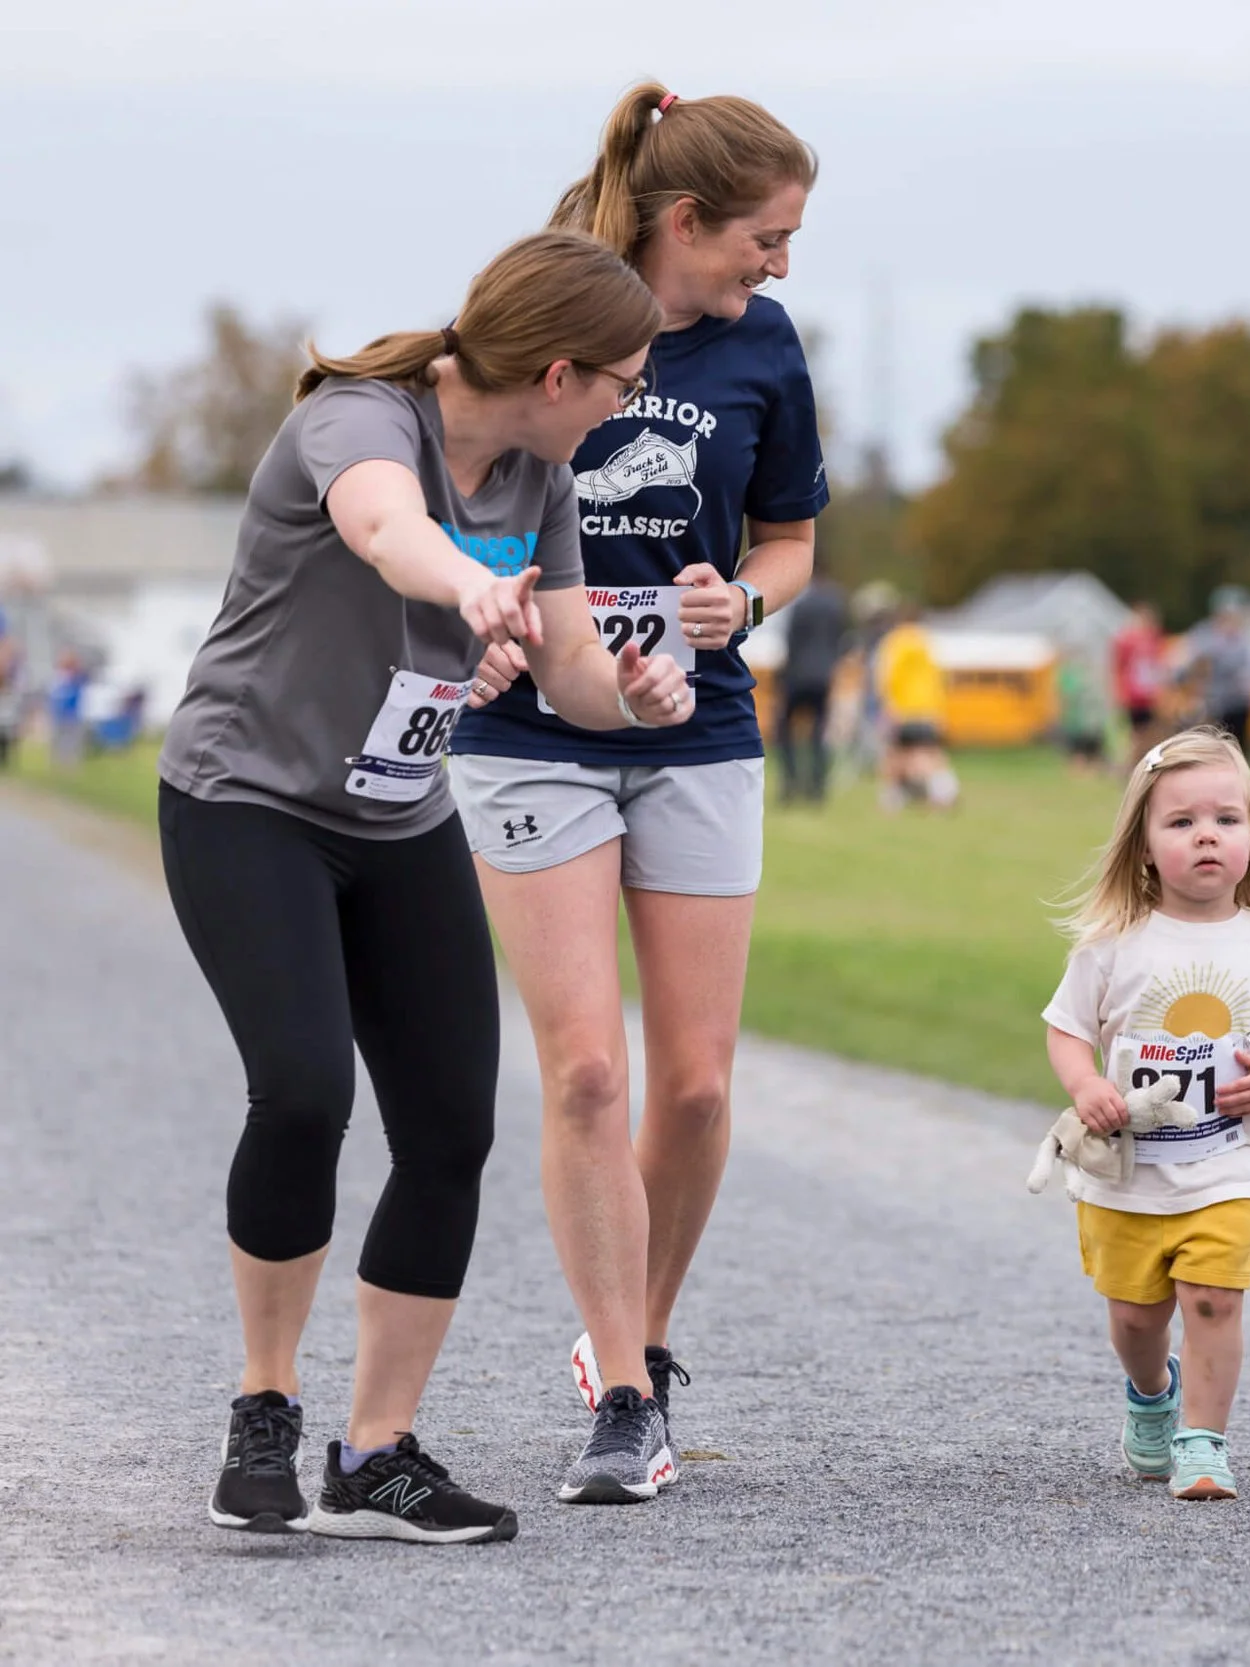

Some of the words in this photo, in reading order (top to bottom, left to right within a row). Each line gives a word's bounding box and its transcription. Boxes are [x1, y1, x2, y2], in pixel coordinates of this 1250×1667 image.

[604, 395, 718, 439] RRIOR
[623, 457, 653, 477] Track
[656, 453, 666, 462] &
[641, 461, 668, 481] Field
[581, 515, 689, 539] CLASSIC
[586, 590, 659, 610] MileSplit
[593, 614, 666, 657] 22
[398, 706, 462, 757] 86
[1140, 1043, 1214, 1064] MileSplit
